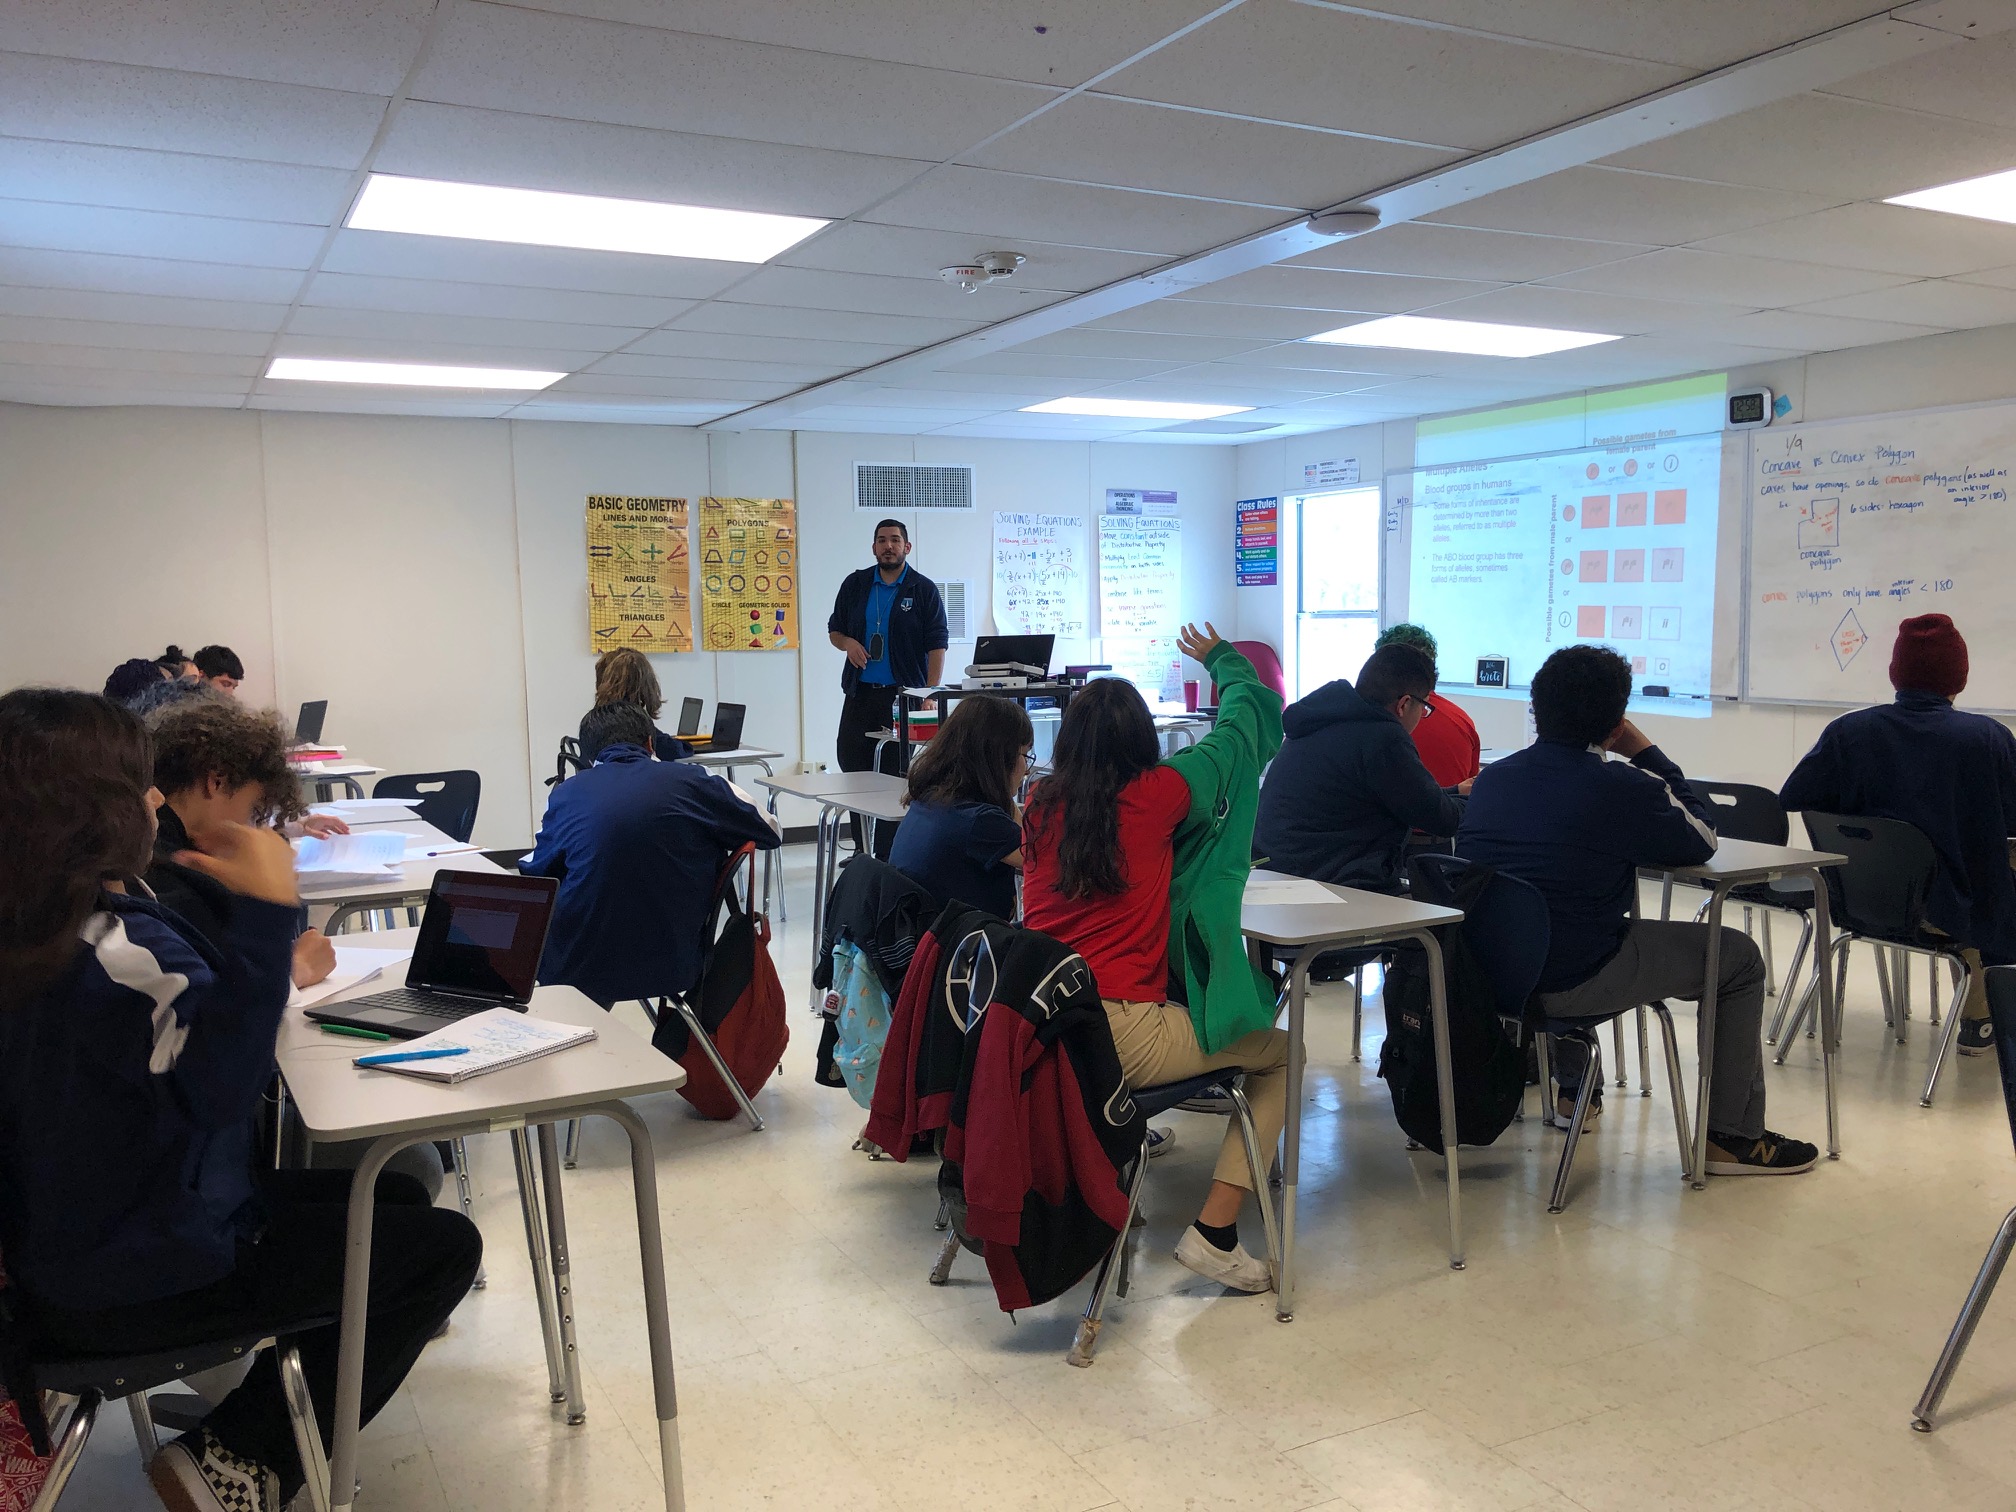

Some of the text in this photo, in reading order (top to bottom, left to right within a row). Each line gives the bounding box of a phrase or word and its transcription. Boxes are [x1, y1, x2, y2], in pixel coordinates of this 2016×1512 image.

[1593, 429, 1677, 445] Possible gametes from
[1632, 444, 1656, 453] parent
[1762, 460, 1801, 474] Concave
[1831, 450, 1865, 464] Convex
[1875, 445, 1915, 466] Polygon
[1792, 482, 1809, 491] have
[1923, 472, 1962, 486] polygons
[1980, 468, 1995, 478] well
[1998, 469, 2007, 477] as
[1425, 480, 1512, 495] Blood groups in humans
[1962, 484, 1990, 492] interior
[589, 496, 686, 513] BASIC GEOMETRY
[1238, 500, 1276, 511] Class Rules
[1434, 502, 1450, 510] Some
[1451, 500, 1466, 508] forms
[1475, 498, 1508, 507] inheritance
[1889, 500, 1924, 513] hexagon
[1954, 496, 1976, 507] angle
[603, 514, 627, 522] LINES
[1434, 509, 1518, 521] determined by more than two
[1036, 514, 1082, 528] EQUATIONS
[1100, 517, 1180, 530] SOLVING EQUATIONS
[1476, 522, 1483, 530] to
[1493, 520, 1517, 529] multiple
[1018, 527, 1056, 537] EXAMPLE
[1120, 532, 1147, 540] constant
[1433, 553, 1443, 561] The
[1459, 553, 1475, 561] blood
[1476, 553, 1494, 562] group
[1495, 552, 1506, 560] has
[1507, 552, 1524, 560] three
[1432, 565, 1447, 573] forms
[1448, 564, 1454, 572] of
[1476, 564, 1508, 572] sometimes
[1810, 558, 1842, 571] polygon
[1449, 575, 1457, 583] AB
[1796, 589, 1833, 606] polygons
[1843, 587, 1861, 605] only
[1935, 579, 1954, 592] 180
[620, 614, 665, 622] TRIANGLES
